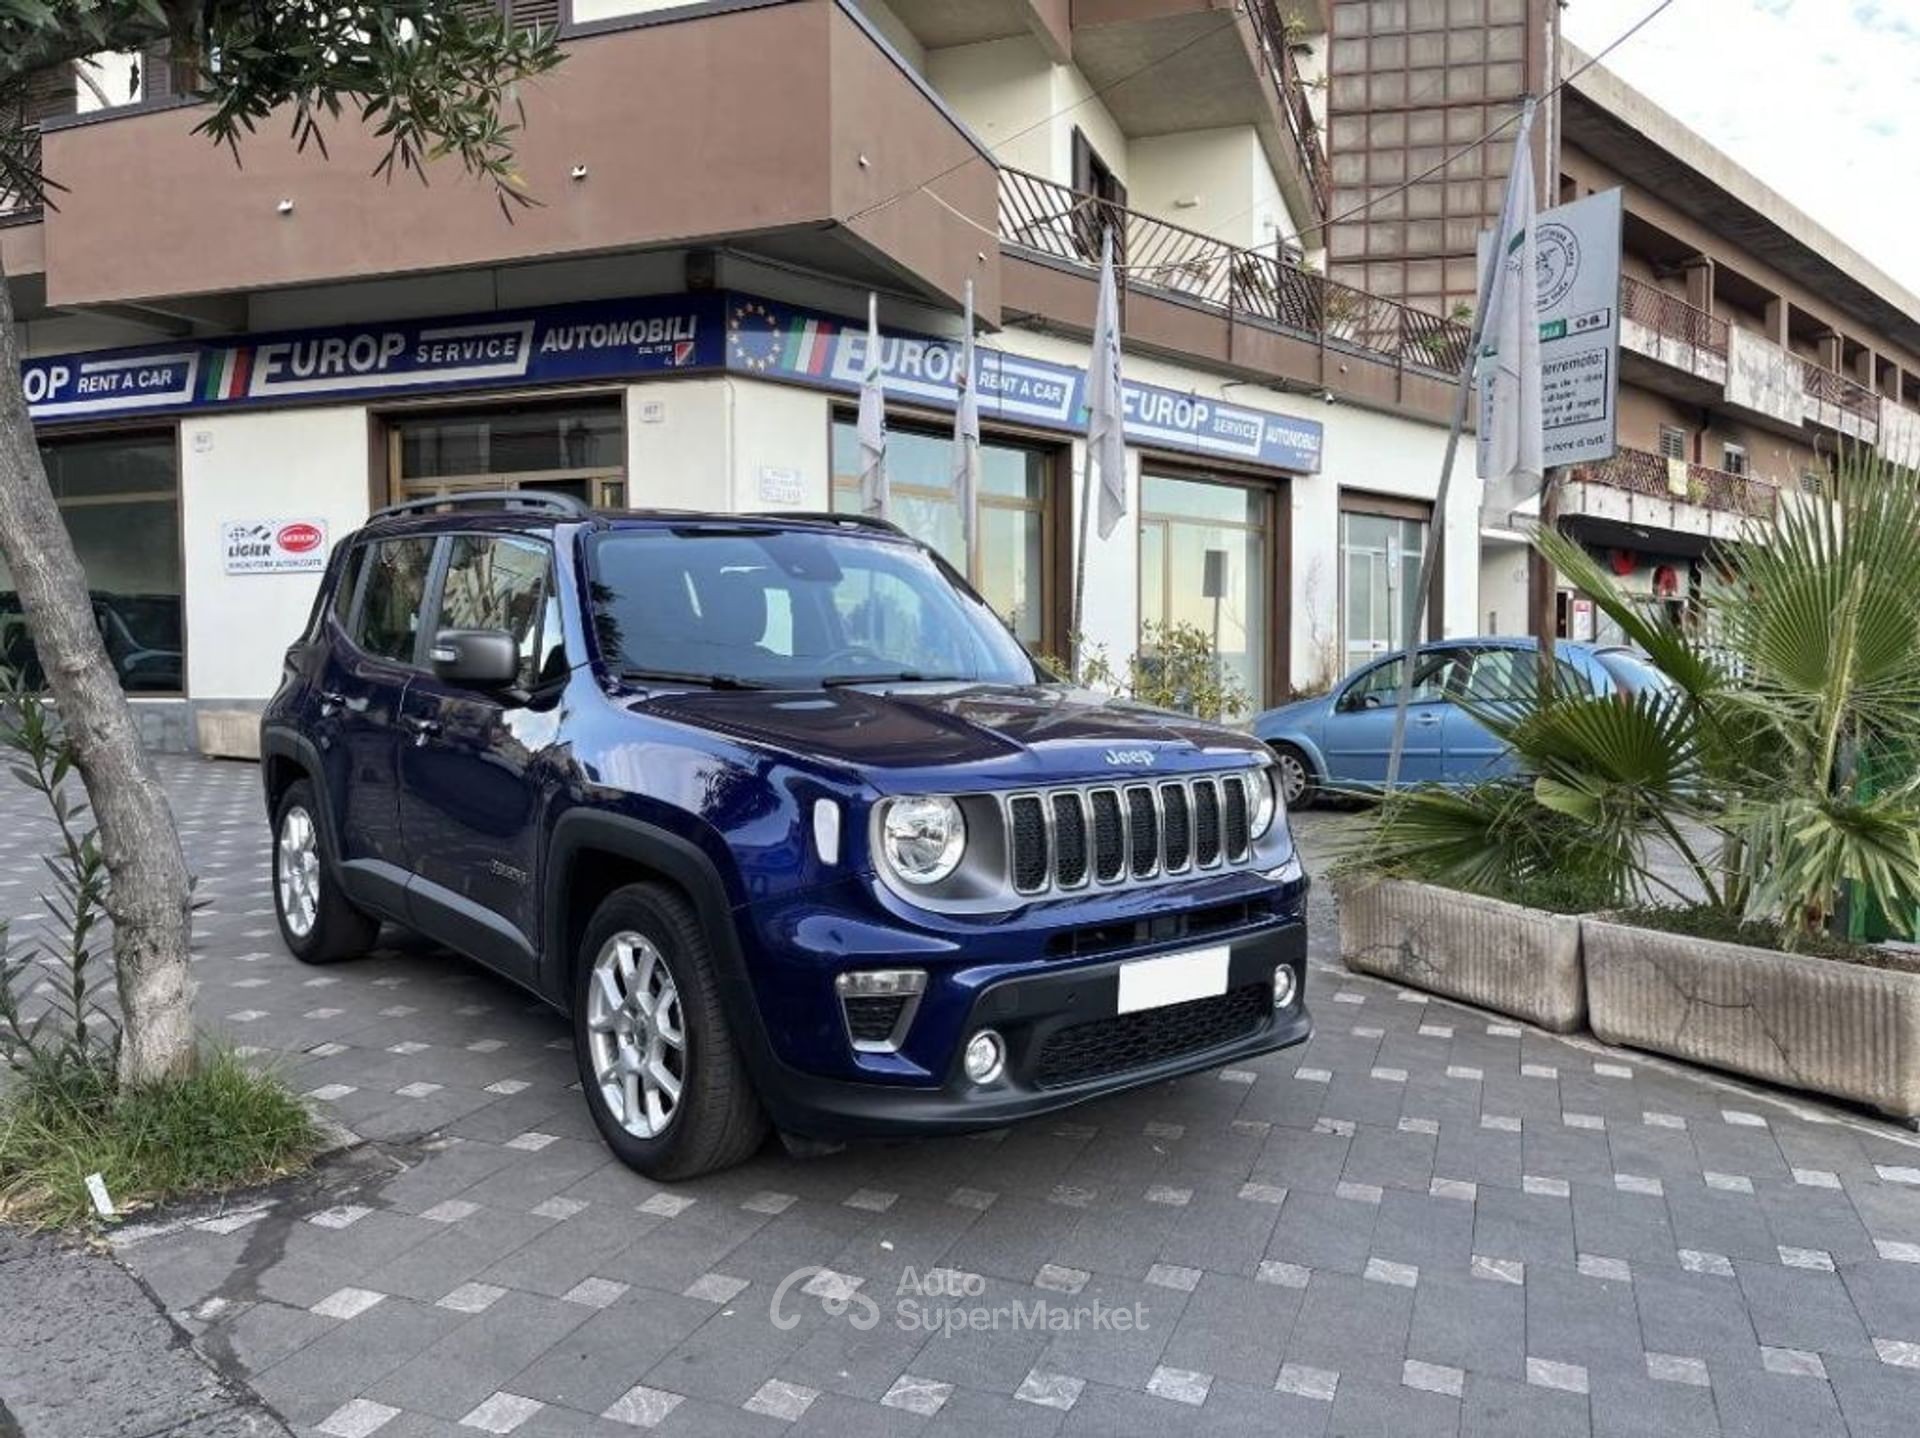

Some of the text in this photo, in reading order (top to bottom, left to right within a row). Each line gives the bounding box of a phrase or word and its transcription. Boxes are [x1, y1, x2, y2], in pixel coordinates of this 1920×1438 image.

[541, 315, 697, 352] AUTOMOBILI
[249, 332, 516, 396] EUROP SERVICE
[77, 373, 121, 393] RENT
[122, 375, 134, 388] A
[138, 368, 172, 387] CAR
[979, 371, 1018, 392] RENT
[1020, 380, 1030, 396] A
[1033, 382, 1061, 403] CAR
[1121, 386, 1259, 439] EUROP SERVICE
[228, 542, 271, 557] LIGIER
[1105, 749, 1155, 767] Jeep
